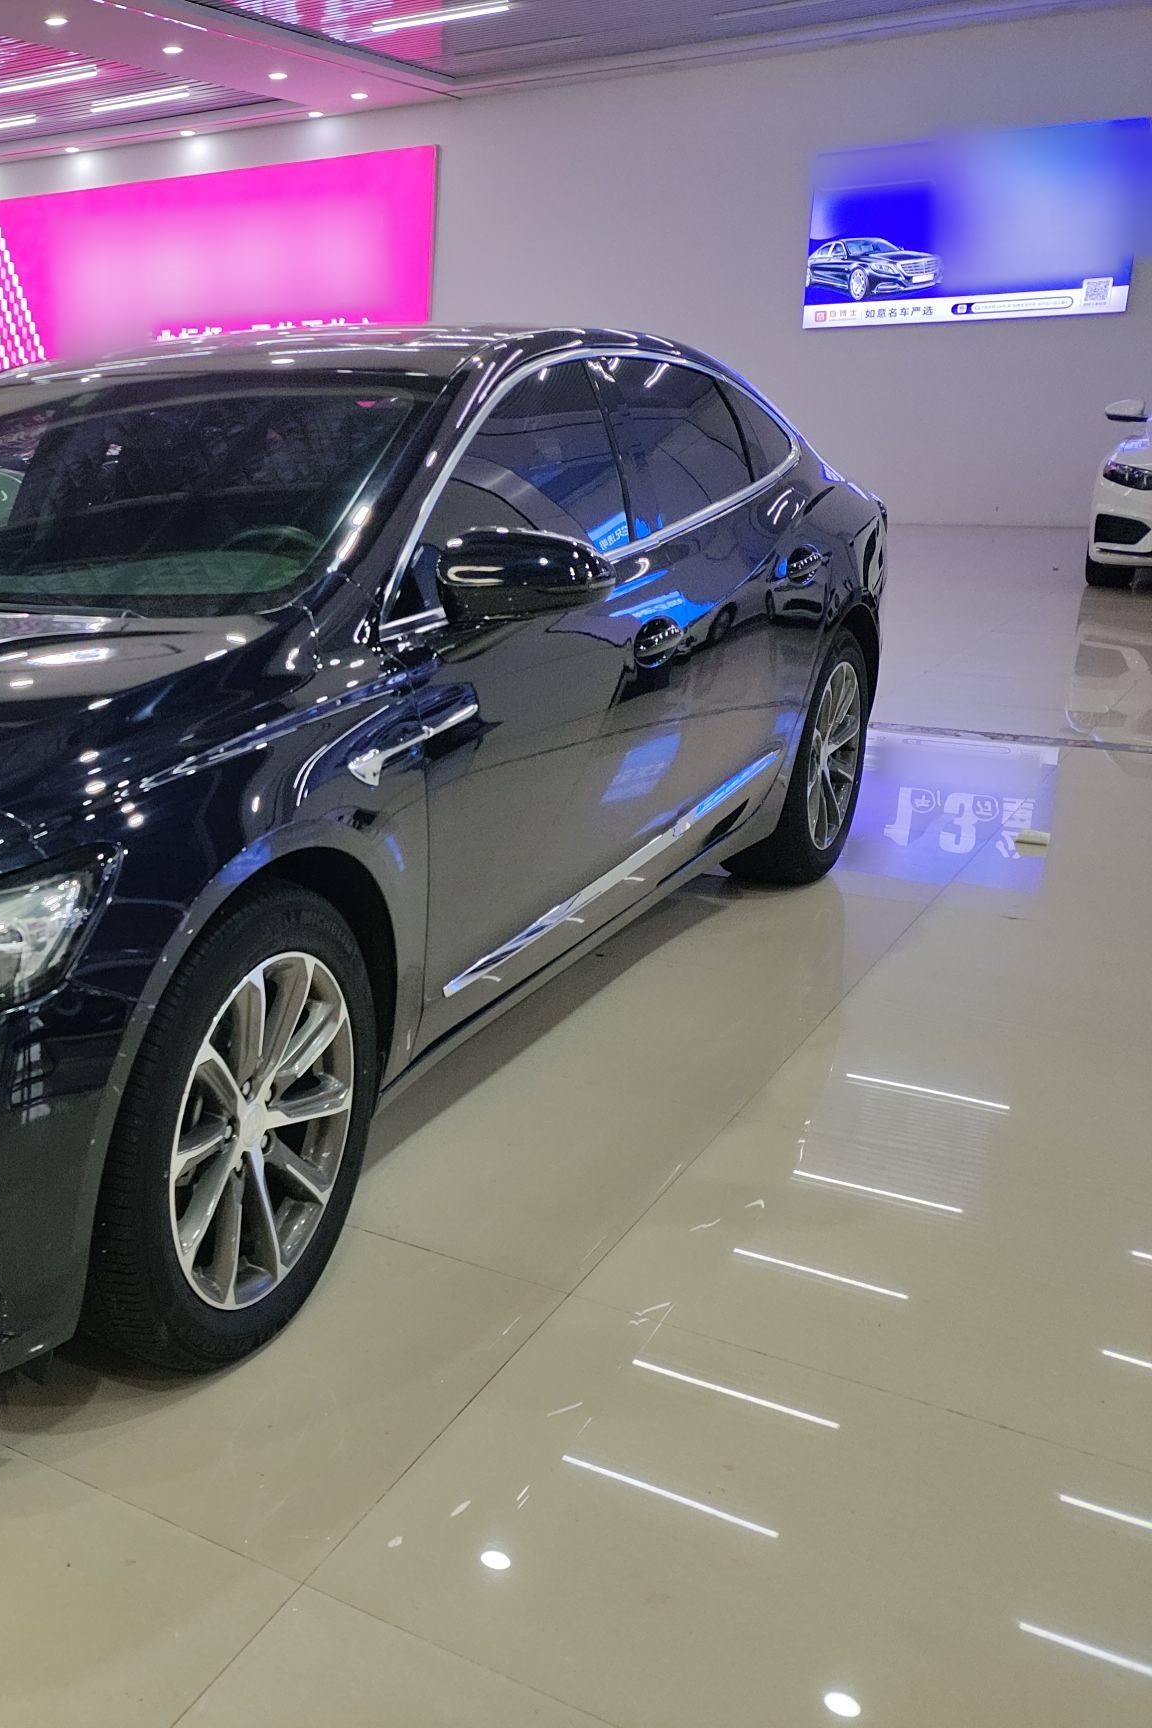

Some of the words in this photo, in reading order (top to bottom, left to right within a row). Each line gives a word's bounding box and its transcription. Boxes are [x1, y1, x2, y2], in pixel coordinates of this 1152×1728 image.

[865, 306, 934, 319] 如意名车严选
